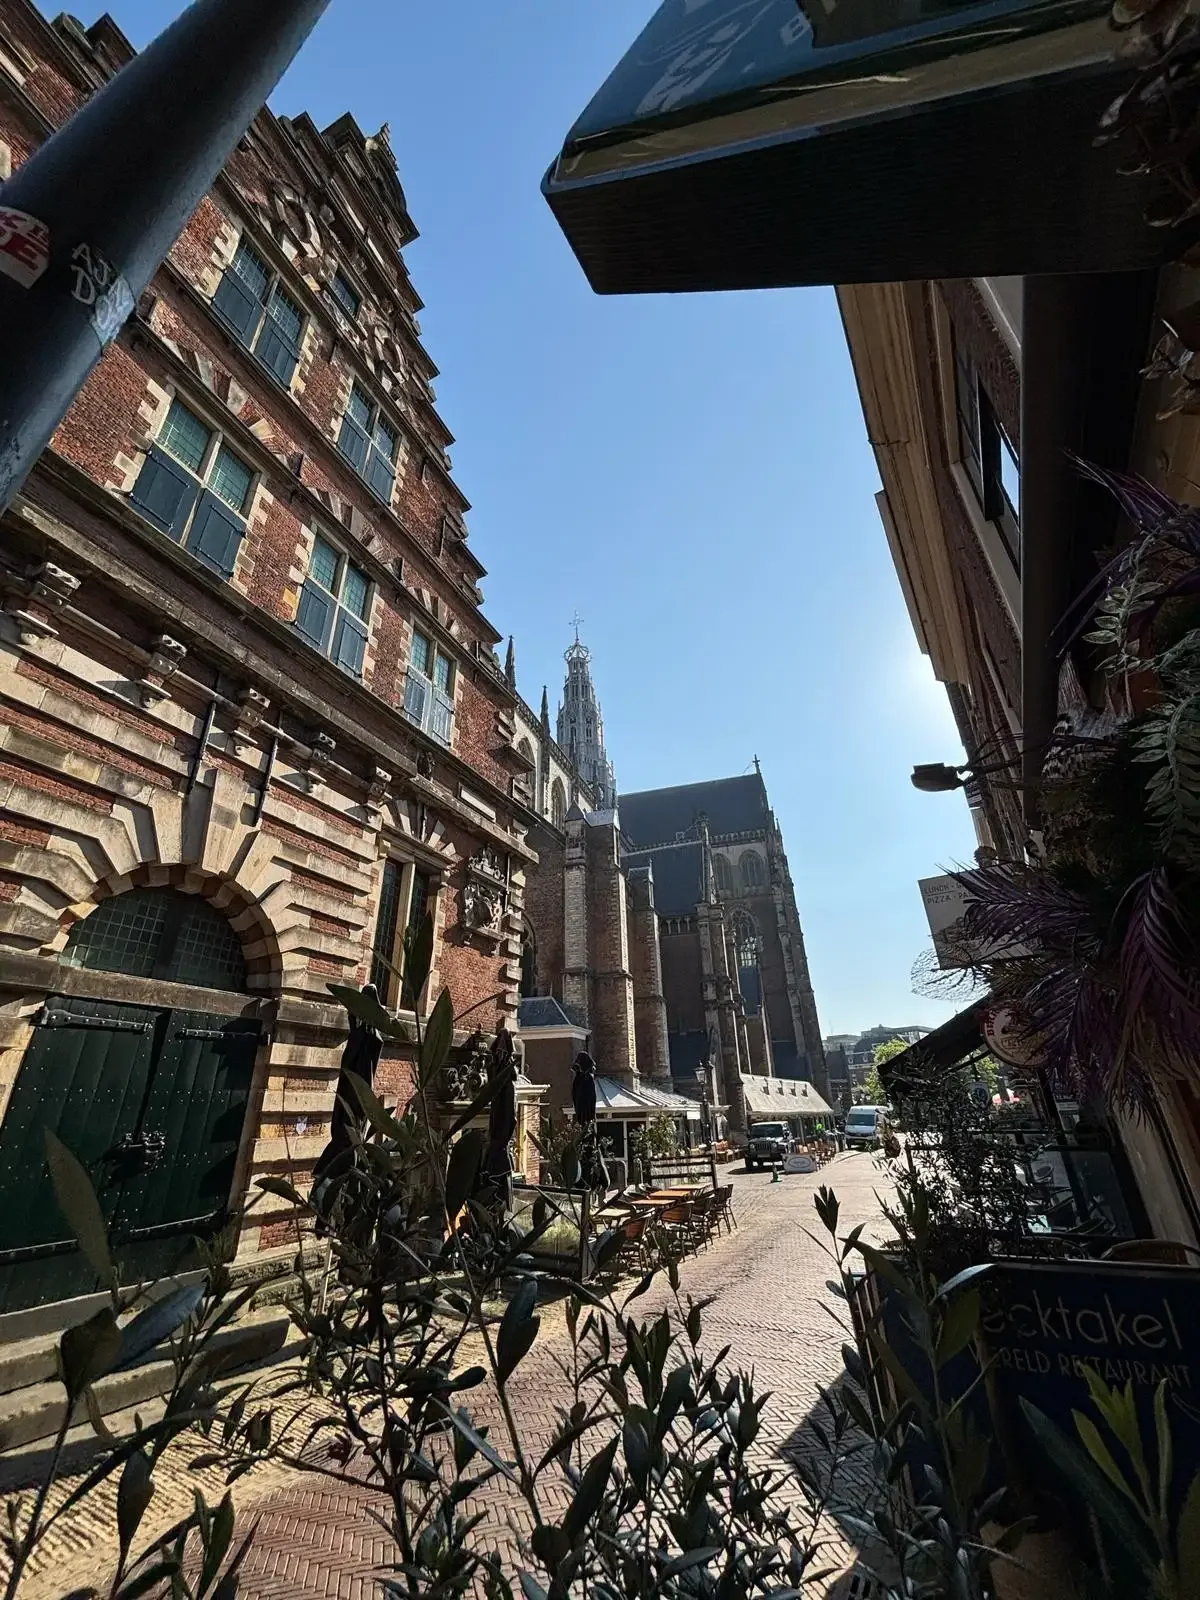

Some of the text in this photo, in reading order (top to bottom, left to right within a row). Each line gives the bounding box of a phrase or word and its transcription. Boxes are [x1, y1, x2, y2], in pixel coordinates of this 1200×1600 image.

[925, 884, 950, 894] LUNCH
[927, 895, 951, 904] PIZZA
[982, 1289, 1183, 1350] ecktakel
